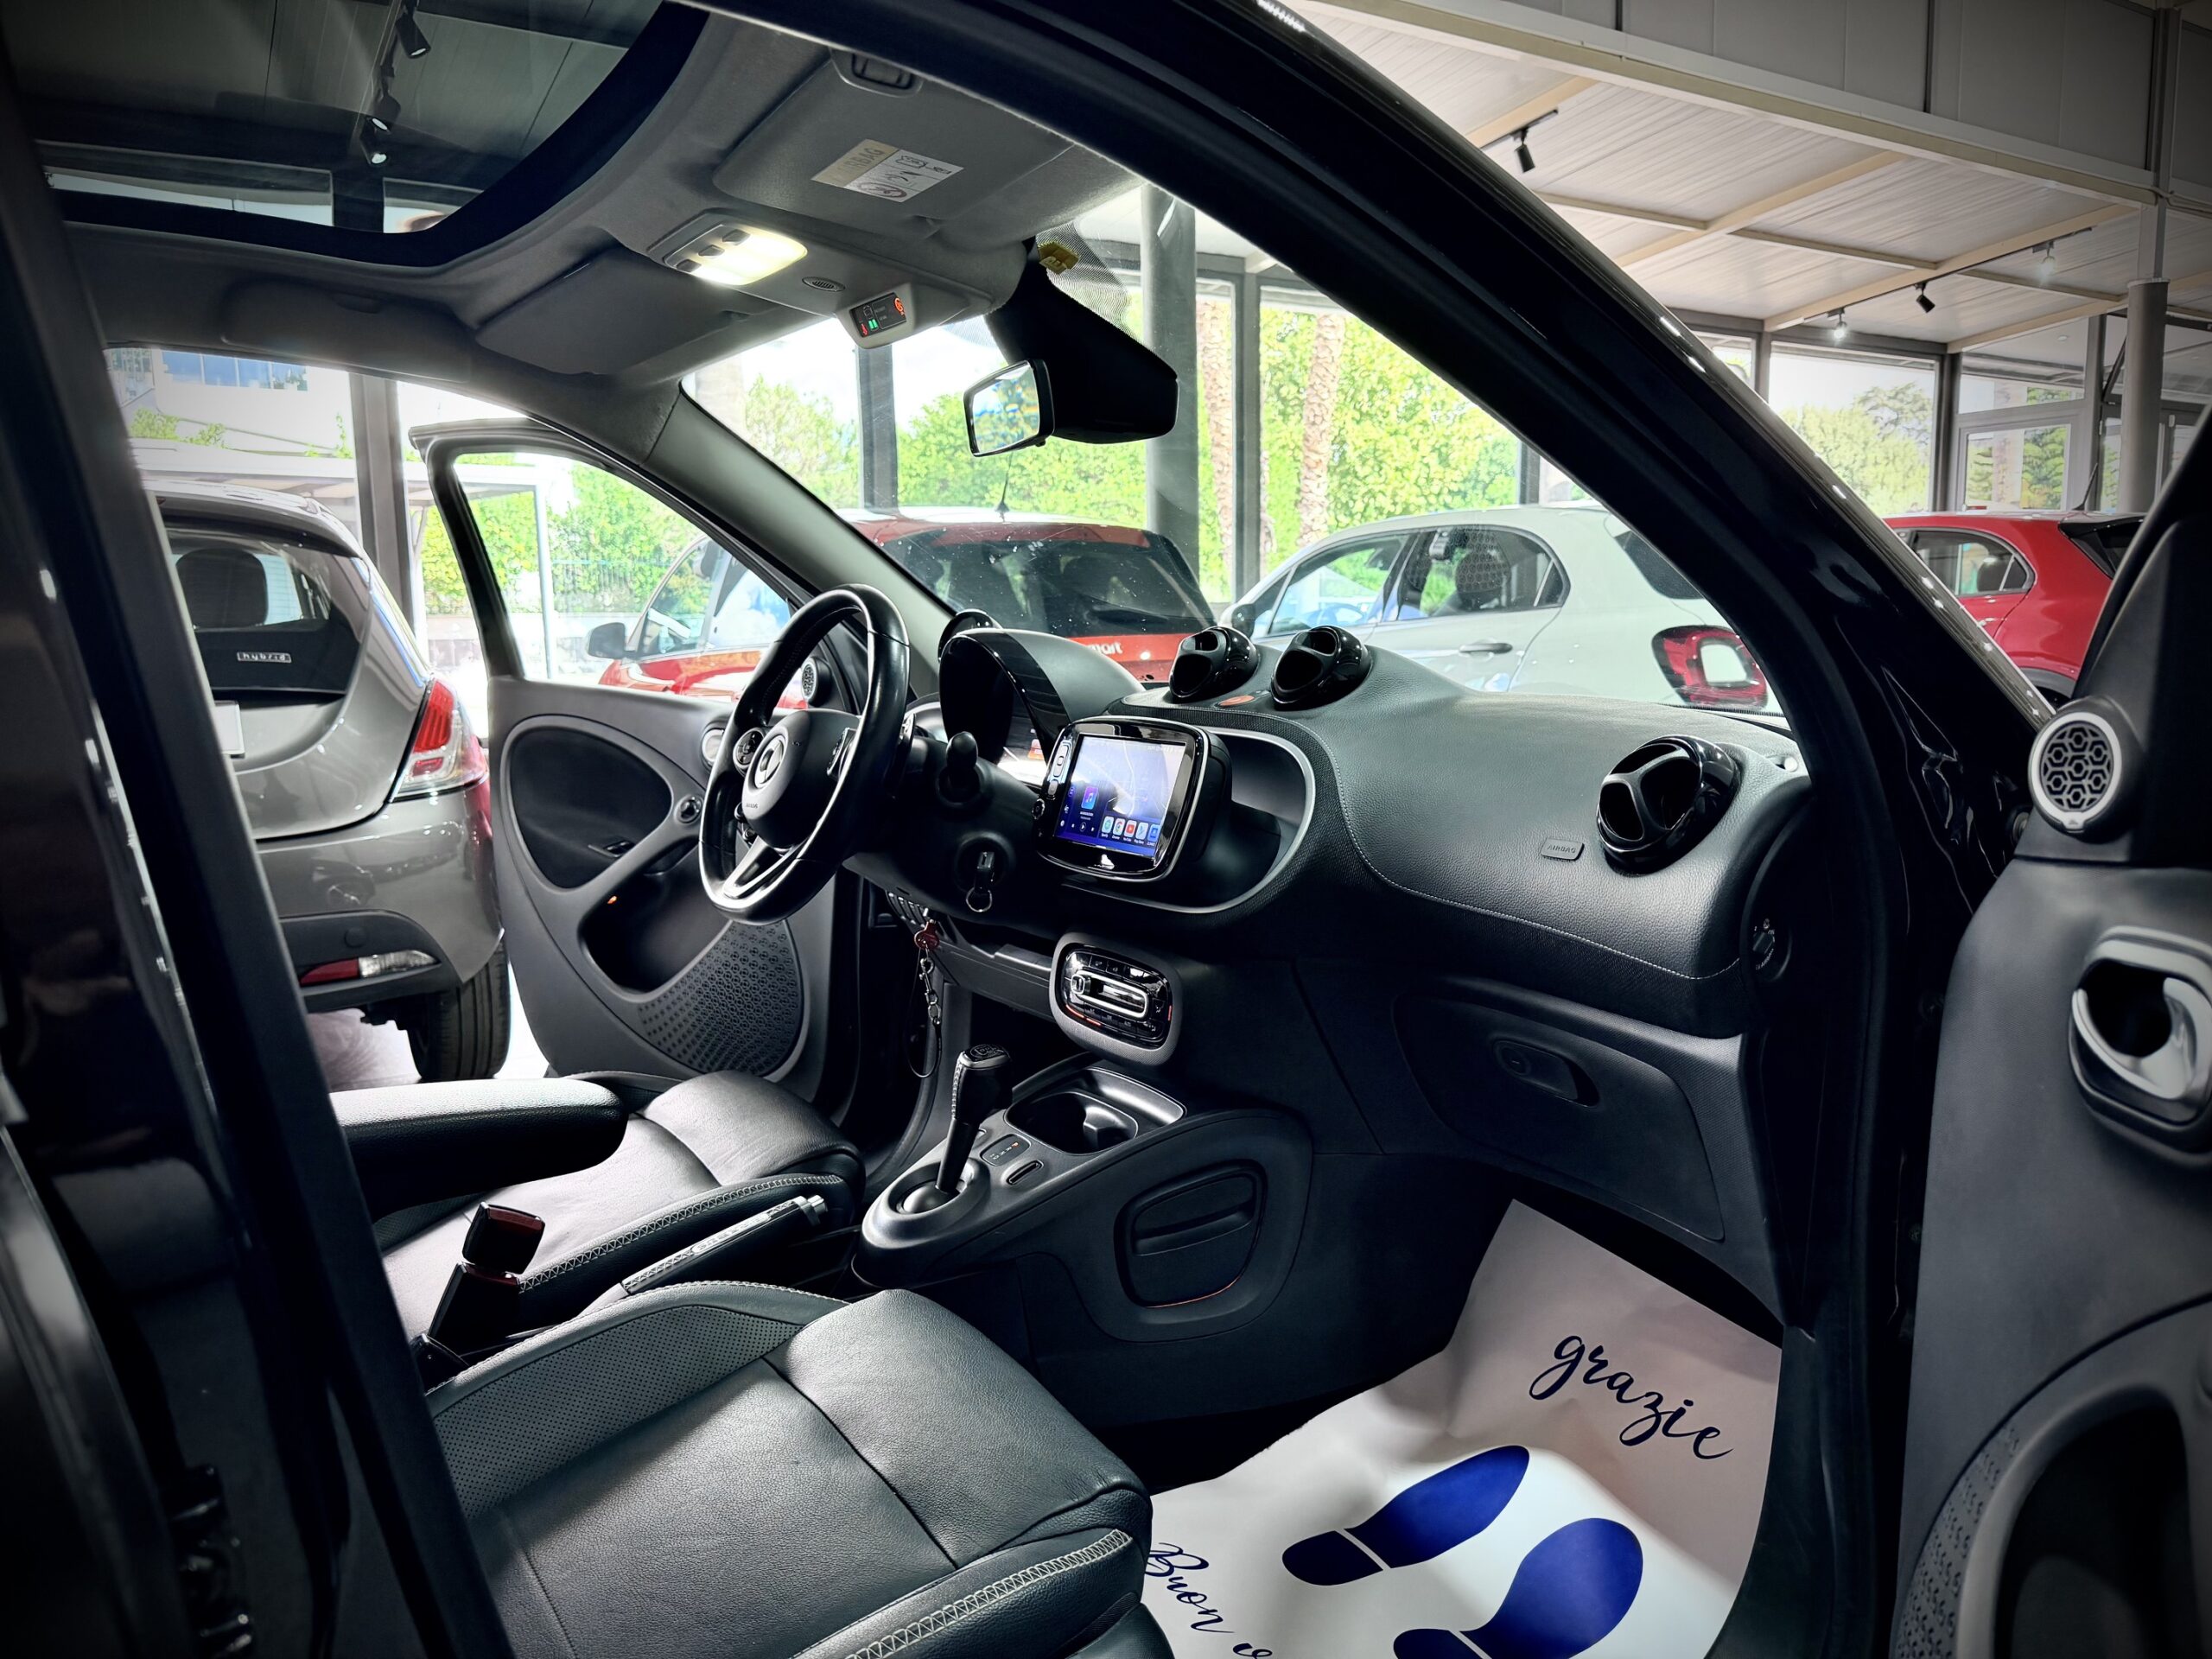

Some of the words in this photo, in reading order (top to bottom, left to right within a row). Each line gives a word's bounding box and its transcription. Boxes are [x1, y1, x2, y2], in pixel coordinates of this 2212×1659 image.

[241, 652, 287, 662] hybrid
[1547, 844, 1577, 854] AIRBAG
[1529, 1335, 1734, 1459] grazie
[1144, 1541, 1236, 1634] Buon
